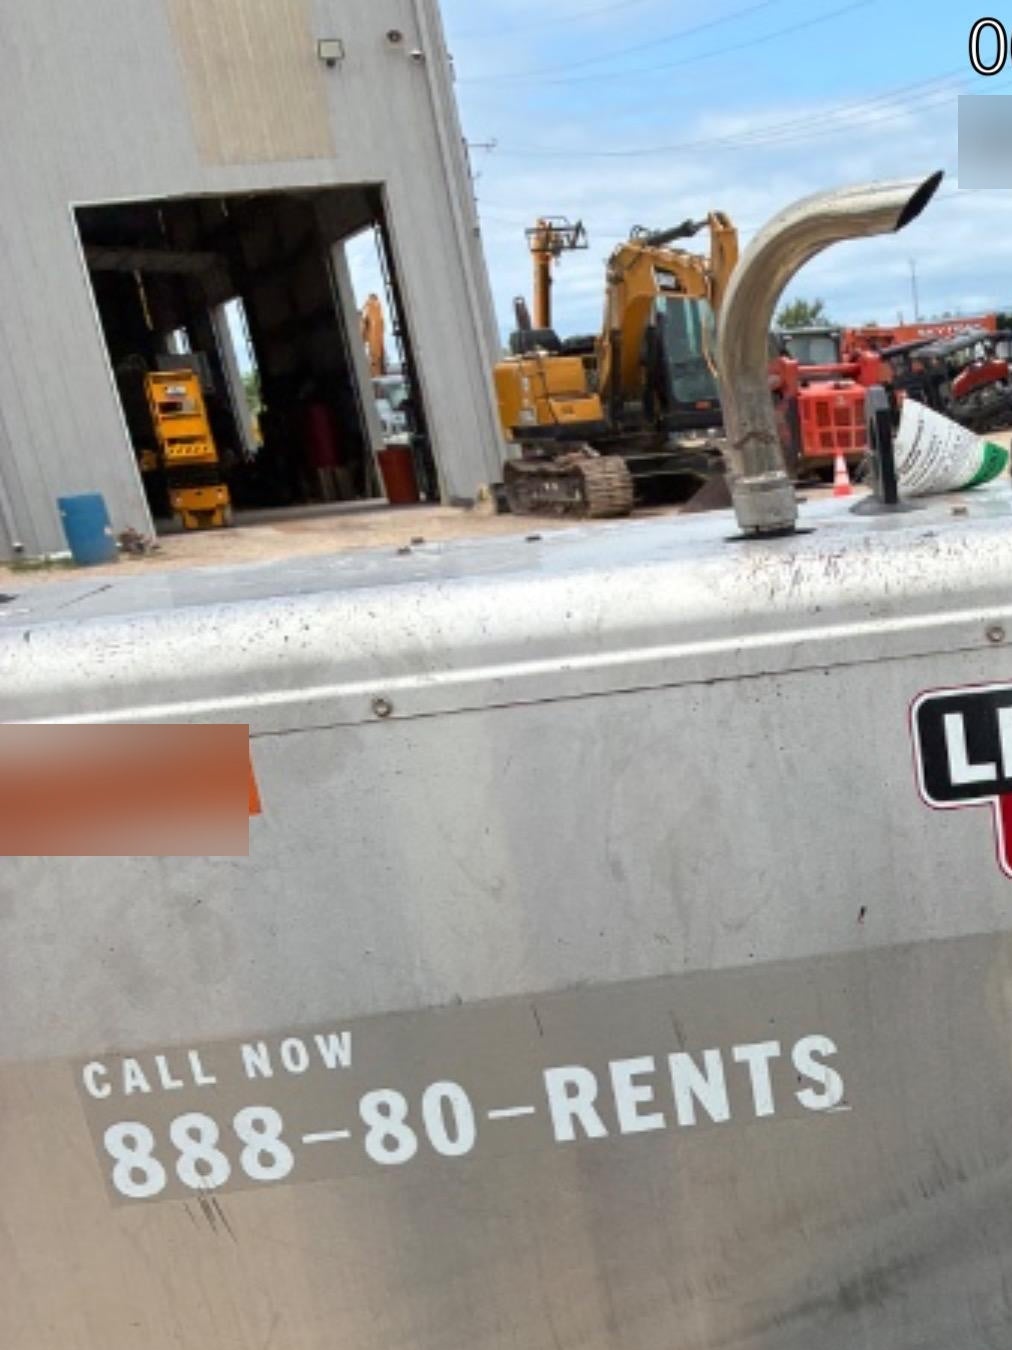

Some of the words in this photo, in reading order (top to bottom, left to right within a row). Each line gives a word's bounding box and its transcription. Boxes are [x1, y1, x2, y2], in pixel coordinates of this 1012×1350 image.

[82, 1051, 217, 1099] CALL
[240, 1030, 353, 1079] NOW
[102, 1034, 845, 1199] 888-80-RENTS
